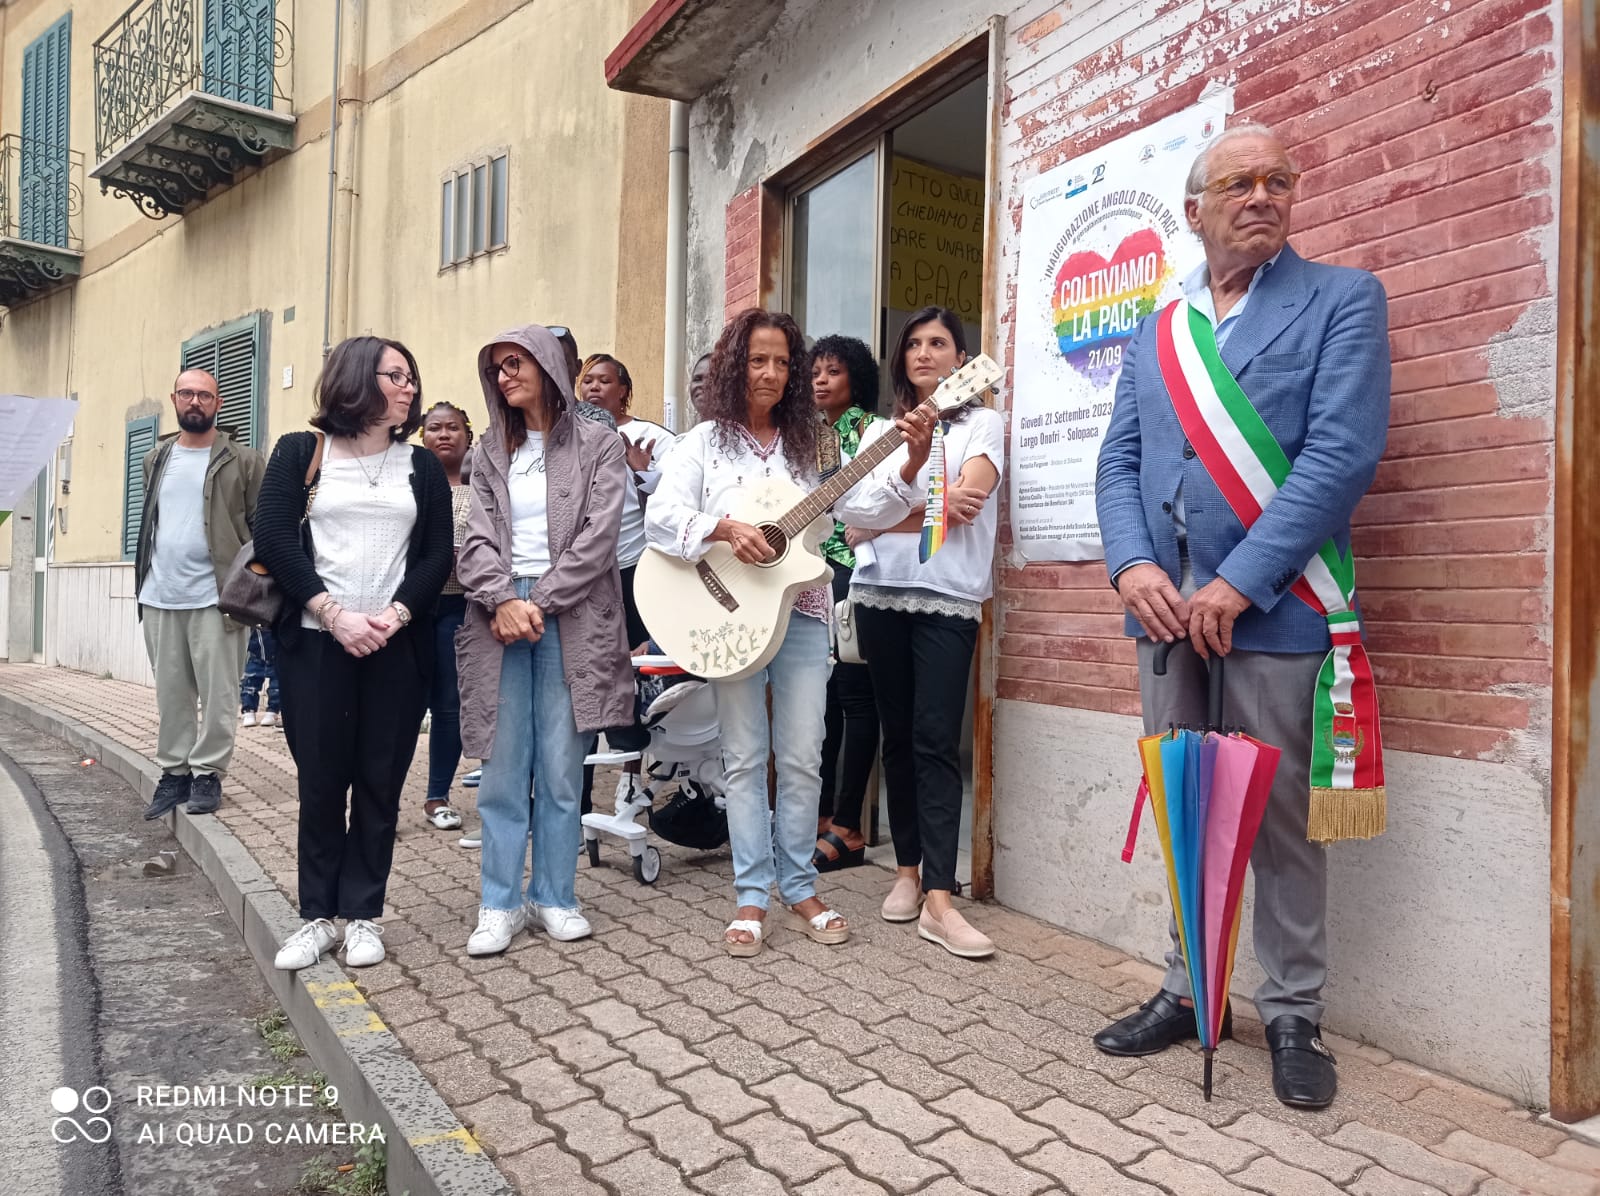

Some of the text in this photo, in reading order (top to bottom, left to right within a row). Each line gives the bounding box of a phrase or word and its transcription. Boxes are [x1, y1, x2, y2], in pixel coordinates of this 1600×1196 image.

[949, 183, 985, 208] QUEL
[896, 200, 968, 231] CHIEDIAMO
[937, 237, 964, 259] UNA
[1044, 200, 1100, 278] INAUGURAZIONE
[1101, 190, 1137, 210] ANGOLO
[1137, 191, 1163, 217] DELLA
[1160, 210, 1180, 239] PACE
[1061, 252, 1158, 310] COLTIVIAMO
[1072, 296, 1140, 342] LA PACE
[1088, 345, 1122, 370] 21/09
[1045, 412, 1053, 426] 21
[1054, 407, 1090, 424] Settembre
[1092, 402, 1113, 418] 2023
[1020, 435, 1039, 449] Largo
[1040, 429, 1060, 445] Onofri
[1067, 426, 1099, 442] Solopaca
[700, 630, 761, 673] PEACE
